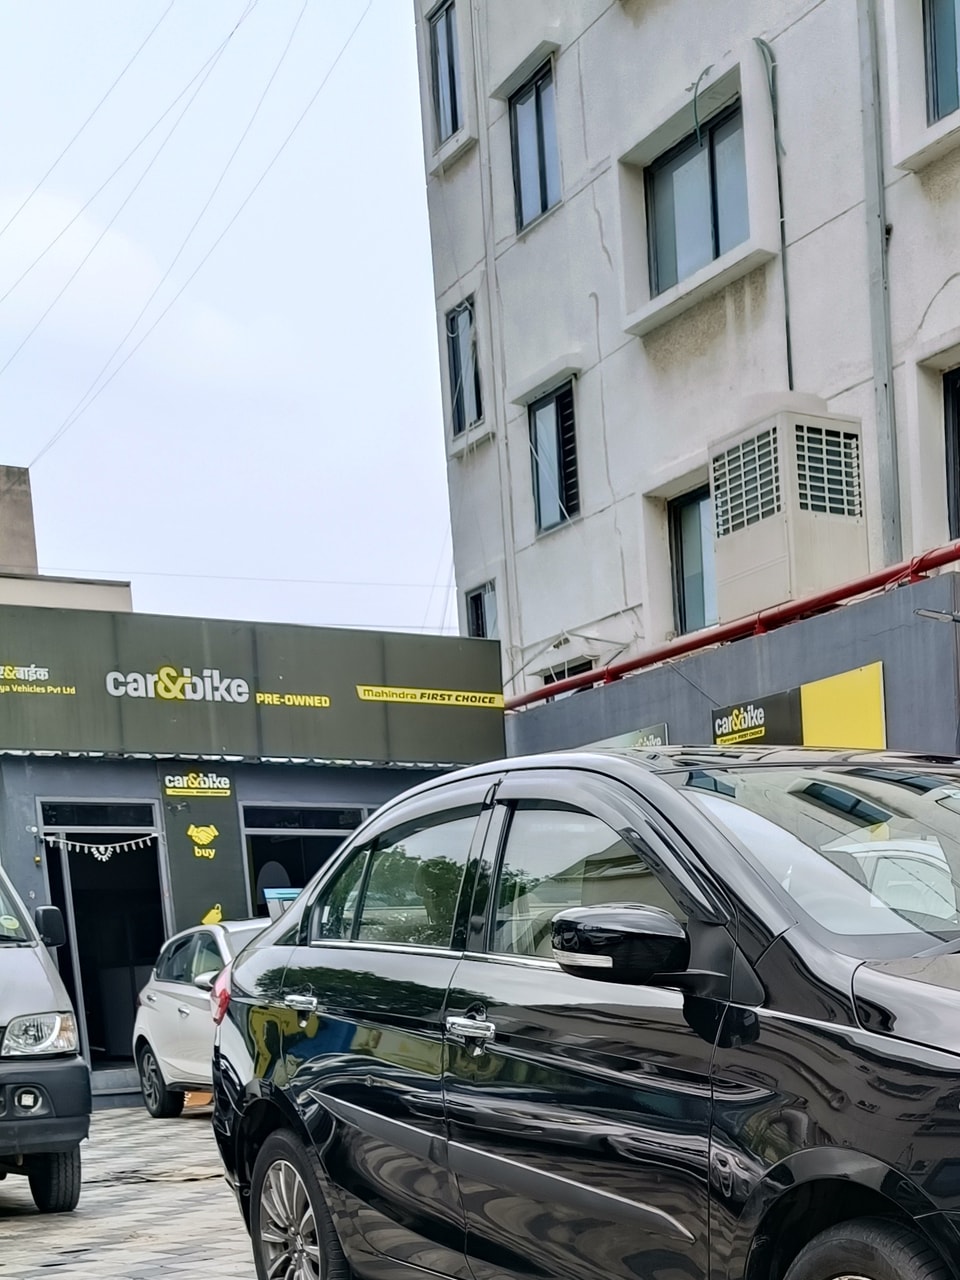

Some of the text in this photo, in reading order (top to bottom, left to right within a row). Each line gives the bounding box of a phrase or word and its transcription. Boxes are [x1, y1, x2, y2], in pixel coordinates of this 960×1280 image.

[11, 684, 46, 694] Vehicles
[47, 685, 61, 694] Pvt
[105, 665, 250, 703] car&bike
[256, 692, 331, 707] PRE-OWNED
[363, 688, 496, 704] Mahindra FIRST CHOICE
[715, 704, 765, 736] car&bike
[164, 772, 230, 788] car&bike
[194, 846, 216, 859] buy
